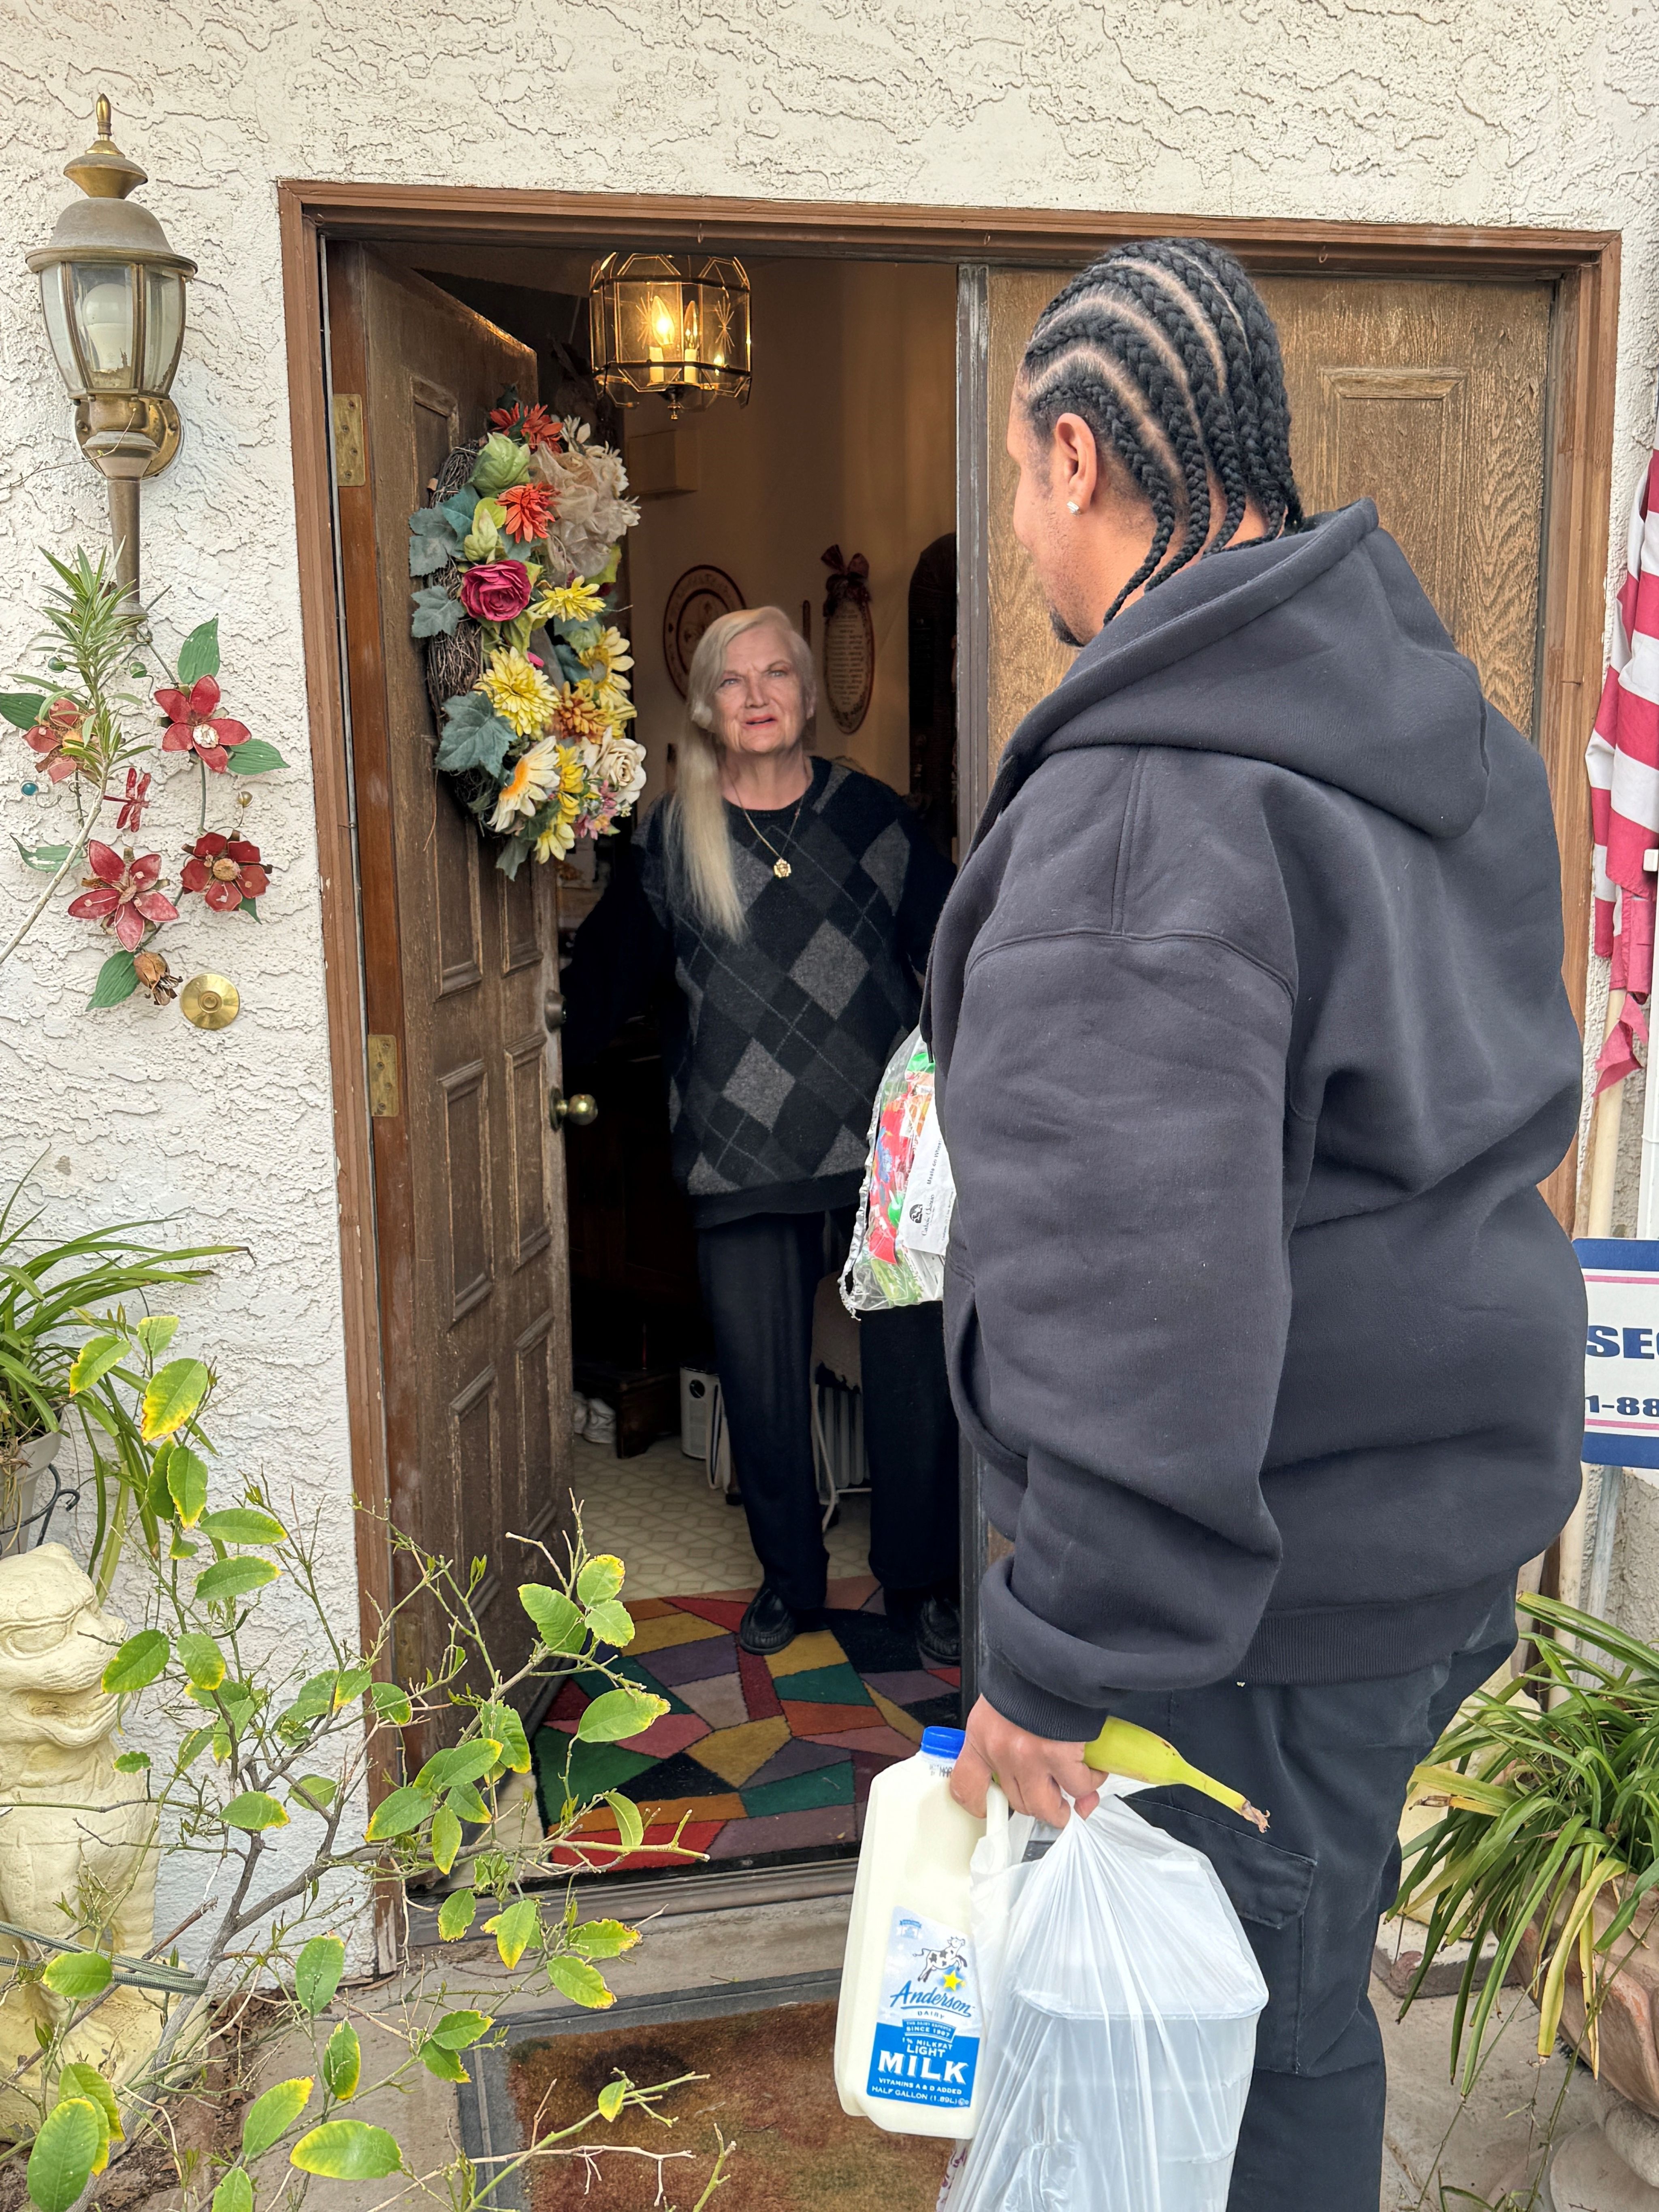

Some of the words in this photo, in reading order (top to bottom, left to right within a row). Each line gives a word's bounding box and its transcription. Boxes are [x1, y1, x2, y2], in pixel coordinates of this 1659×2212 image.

[1586, 1325, 1659, 1359] SE
[890, 1980, 971, 2016] Anderson
[917, 2010, 945, 2019] DAIRY
[906, 2044, 946, 2058] LIGHT
[917, 2039, 953, 2051] MILKFAT
[878, 2050, 969, 2085] MILK
[872, 2086, 893, 2095] HALF
[895, 2089, 928, 2100] GALLON
[879, 2077, 913, 2088] VITAMINS
[936, 2087, 962, 2095] ADDED
